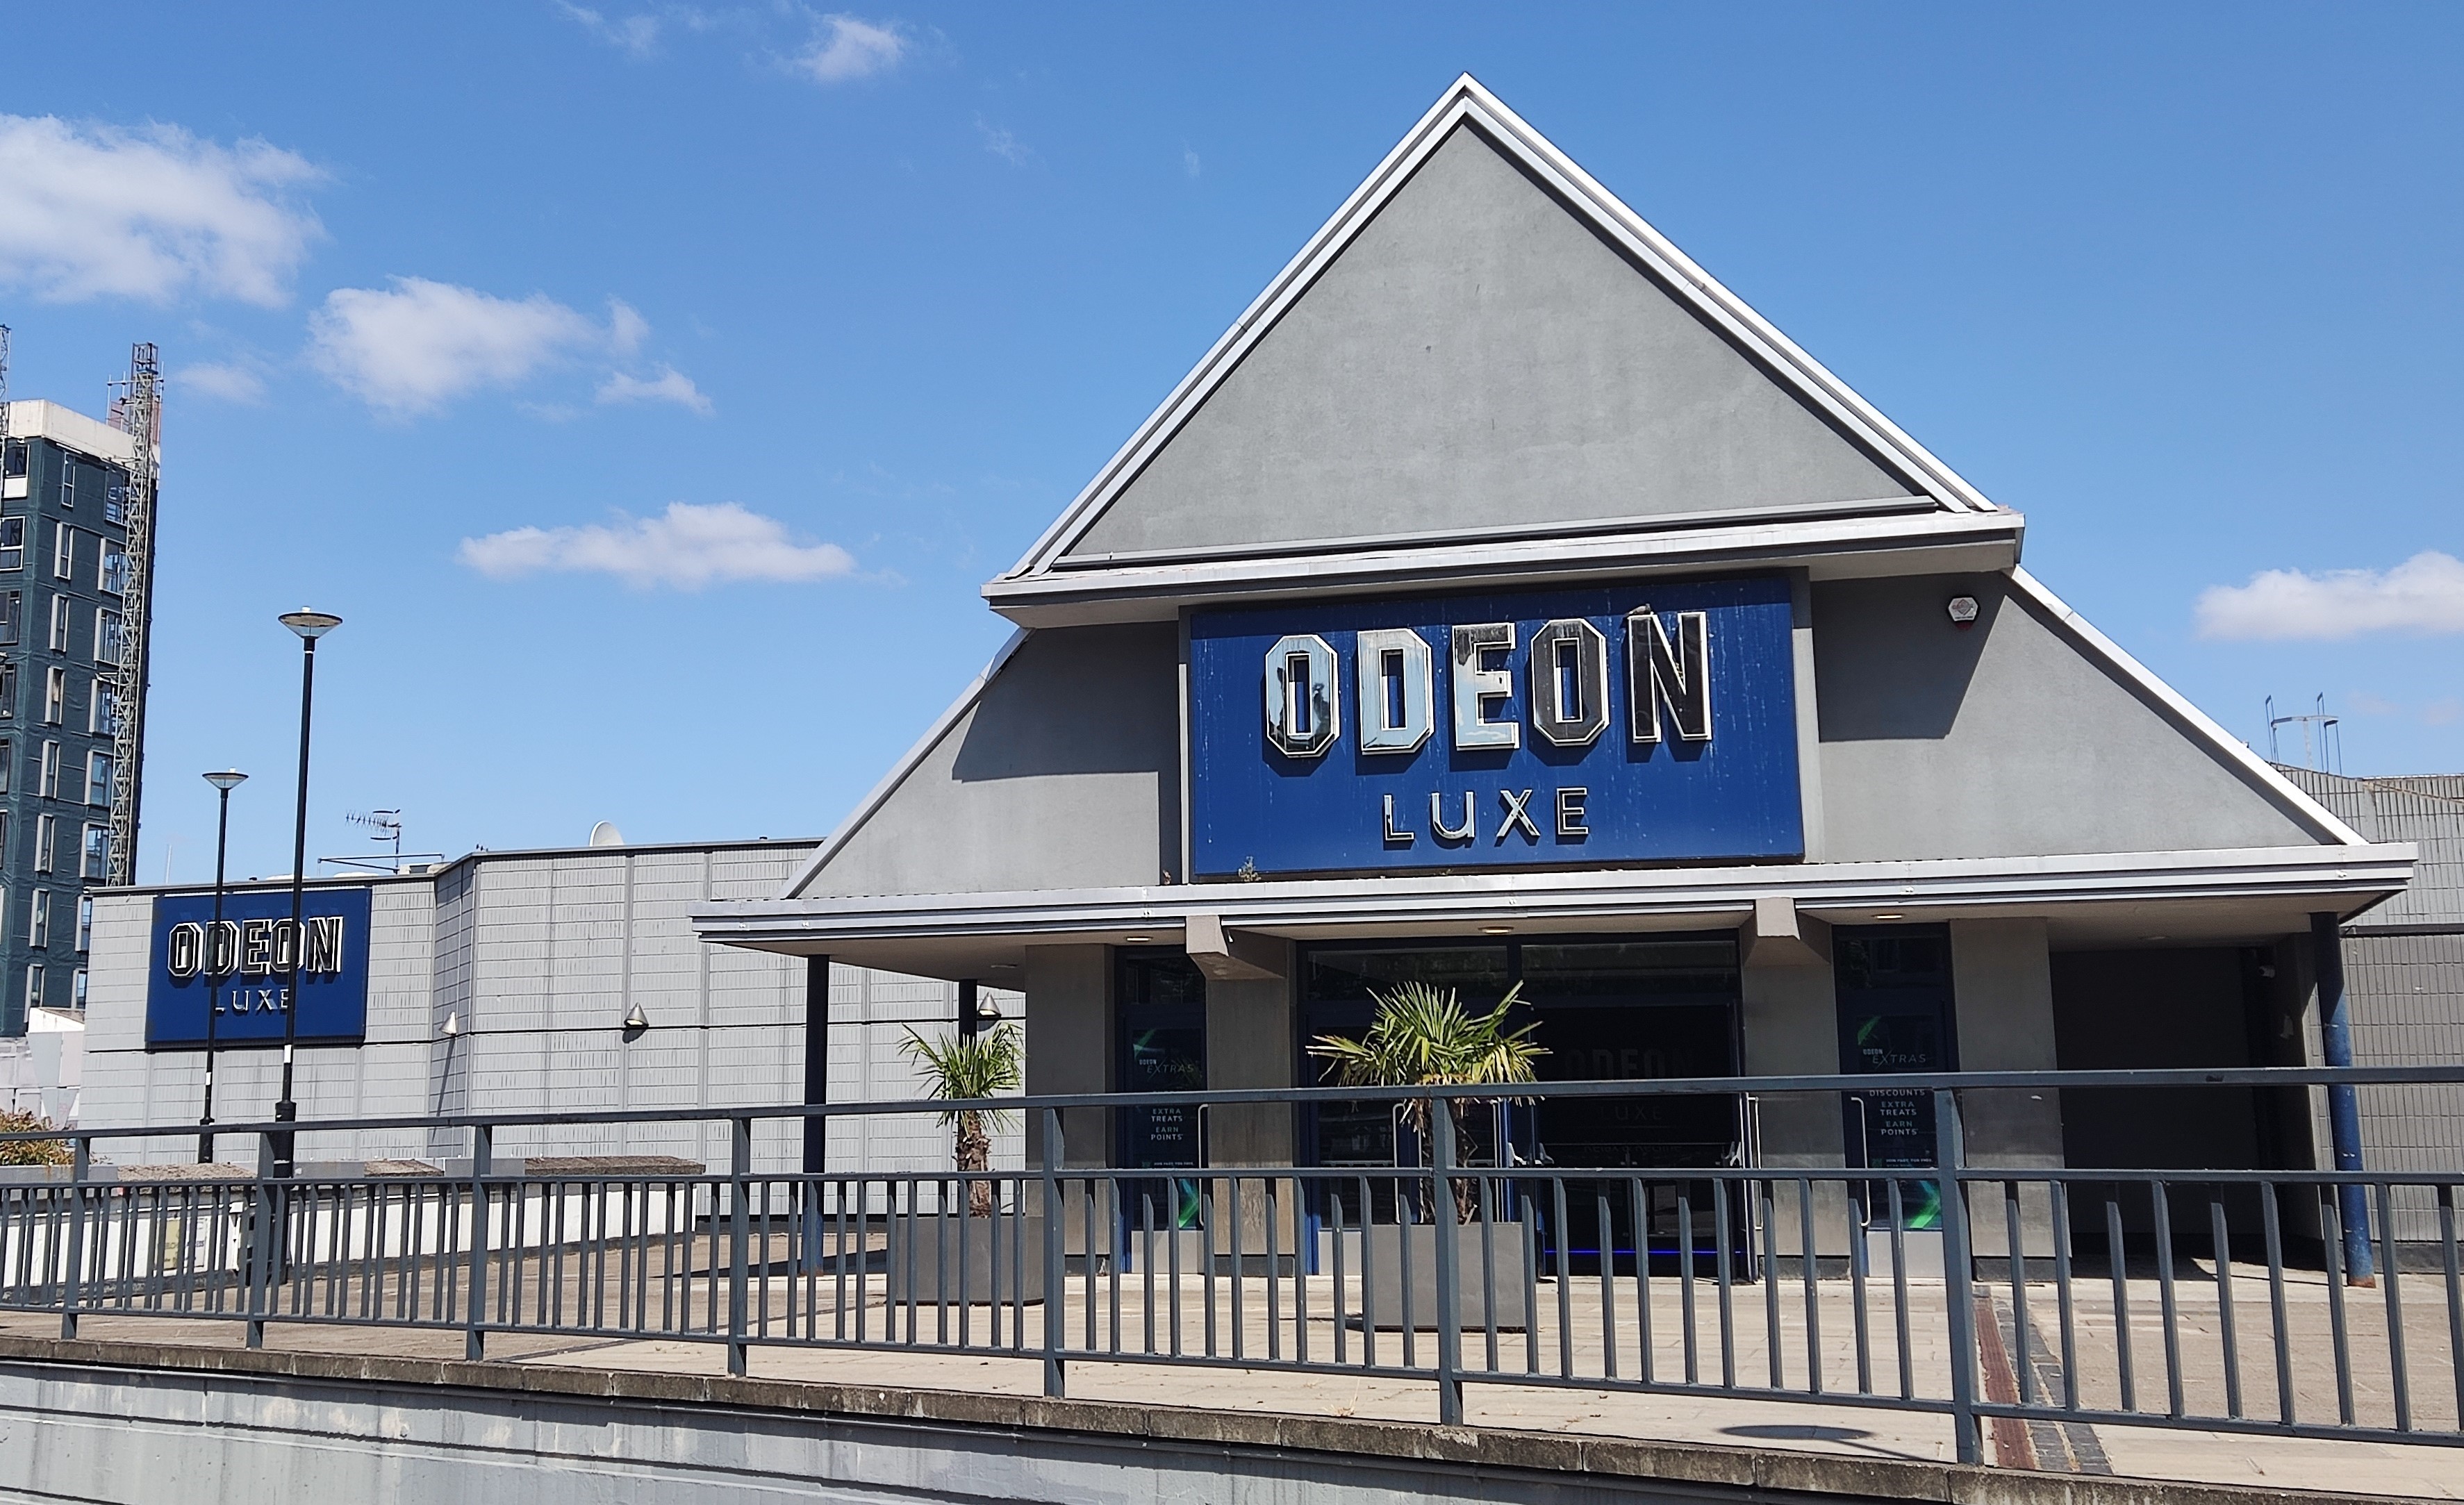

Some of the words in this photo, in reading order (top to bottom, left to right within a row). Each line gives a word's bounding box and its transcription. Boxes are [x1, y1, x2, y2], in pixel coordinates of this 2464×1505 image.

[1265, 611, 1712, 758] ODEON
[1382, 787, 1589, 841] LUXE
[167, 916, 344, 977] ODEON
[1147, 1061, 1194, 1076] EXTRAS
[1872, 1051, 1926, 1066] EXTRAS
